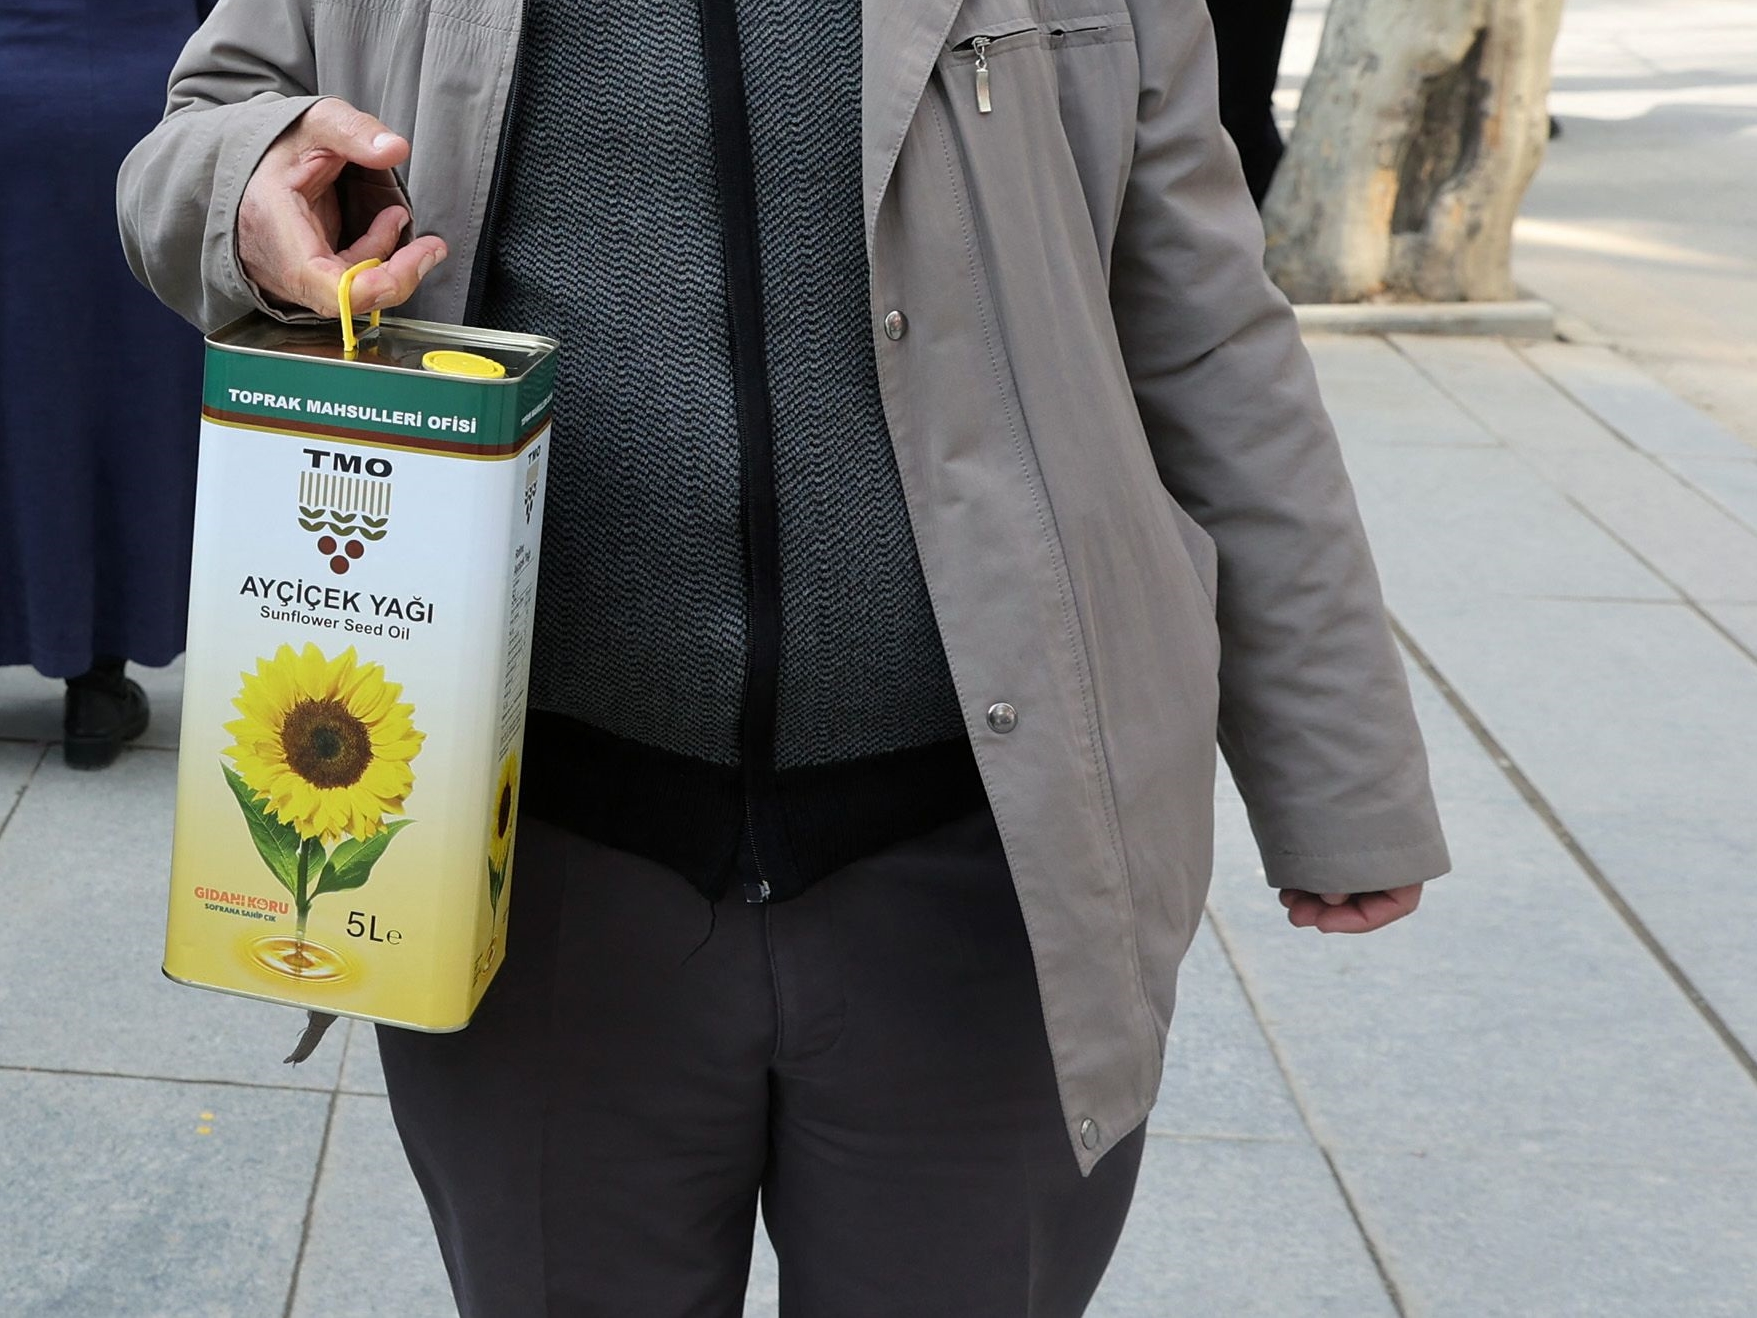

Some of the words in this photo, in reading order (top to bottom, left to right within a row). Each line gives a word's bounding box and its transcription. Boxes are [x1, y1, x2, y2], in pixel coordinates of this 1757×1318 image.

[228, 388, 302, 411] TOPRAK
[306, 399, 422, 427] MAHSULLERİ
[427, 416, 477, 434] OFİSİ
[303, 448, 393, 478] TMO
[240, 575, 361, 611] AYÇİÇEK
[369, 594, 434, 624] YAĞI
[260, 605, 339, 629] Sunflower
[344, 618, 383, 636] Seed
[388, 625, 410, 640] Oil
[193, 886, 245, 906] GIDANI
[247, 897, 289, 915] KORU
[204, 903, 240, 916] SOFRANA
